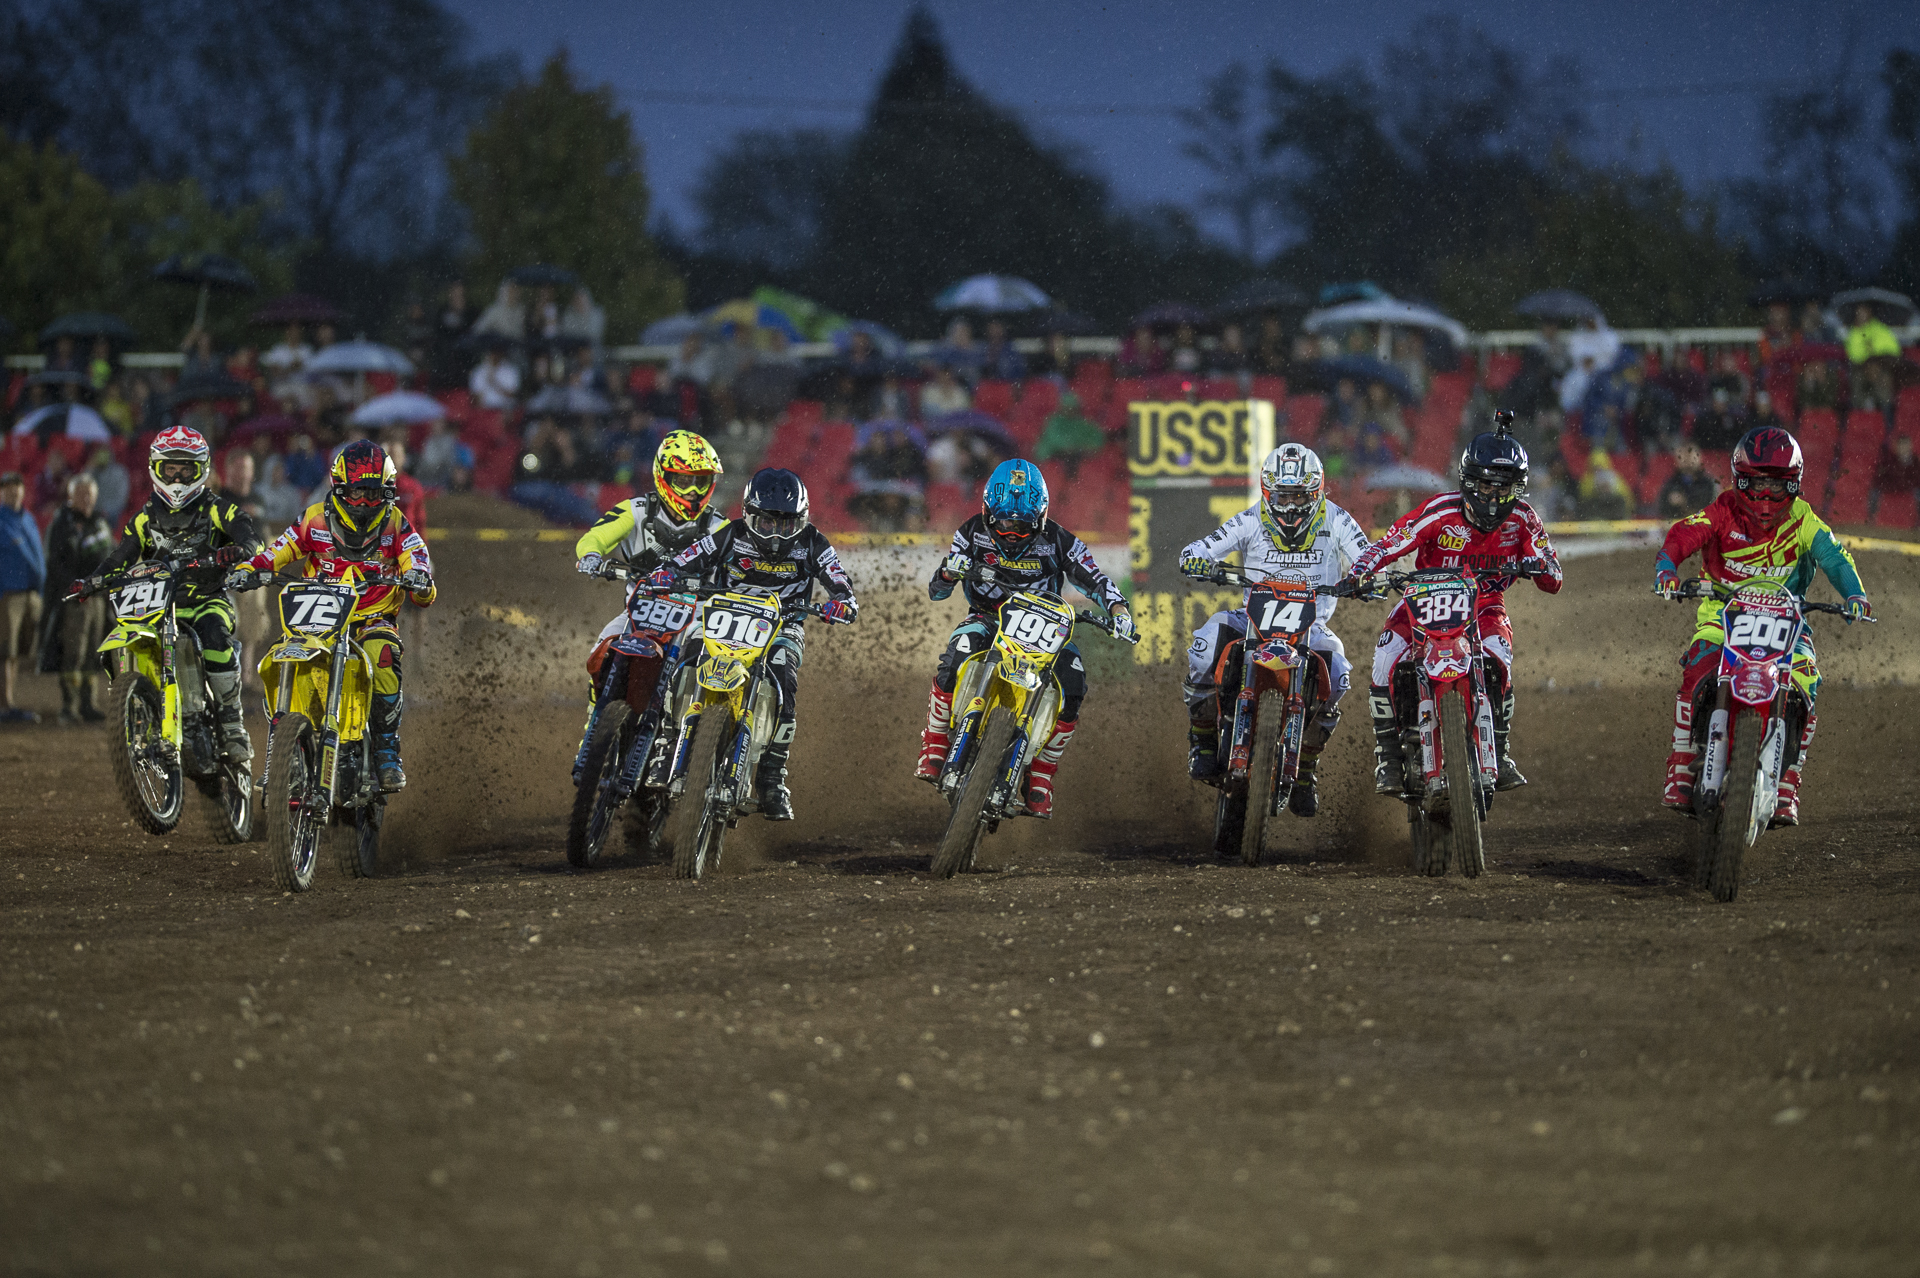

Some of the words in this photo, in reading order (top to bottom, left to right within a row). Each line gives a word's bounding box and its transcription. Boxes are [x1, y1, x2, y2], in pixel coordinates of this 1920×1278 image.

[1439, 535, 1465, 550] MB
[999, 557, 1041, 570] VALENTI
[1725, 559, 1794, 577] Martin
[118, 581, 166, 616] 291
[288, 594, 345, 625] 72
[631, 599, 690, 631] 380
[732, 603, 755, 612] SUPERCROSS
[1030, 605, 1053, 617] SUPERCROSS
[1416, 594, 1472, 625] 384
[705, 611, 773, 648] 910
[1003, 609, 1064, 654] 199
[1259, 600, 1305, 633] 14
[1729, 614, 1792, 651] 200
[623, 734, 647, 780] PIRELLI
[947, 717, 969, 763] CASTELLARI
[1773, 732, 1782, 779] DUNLOP
[735, 733, 750, 782] CASTELLARI
[1008, 739, 1027, 787] CASTELLARI
